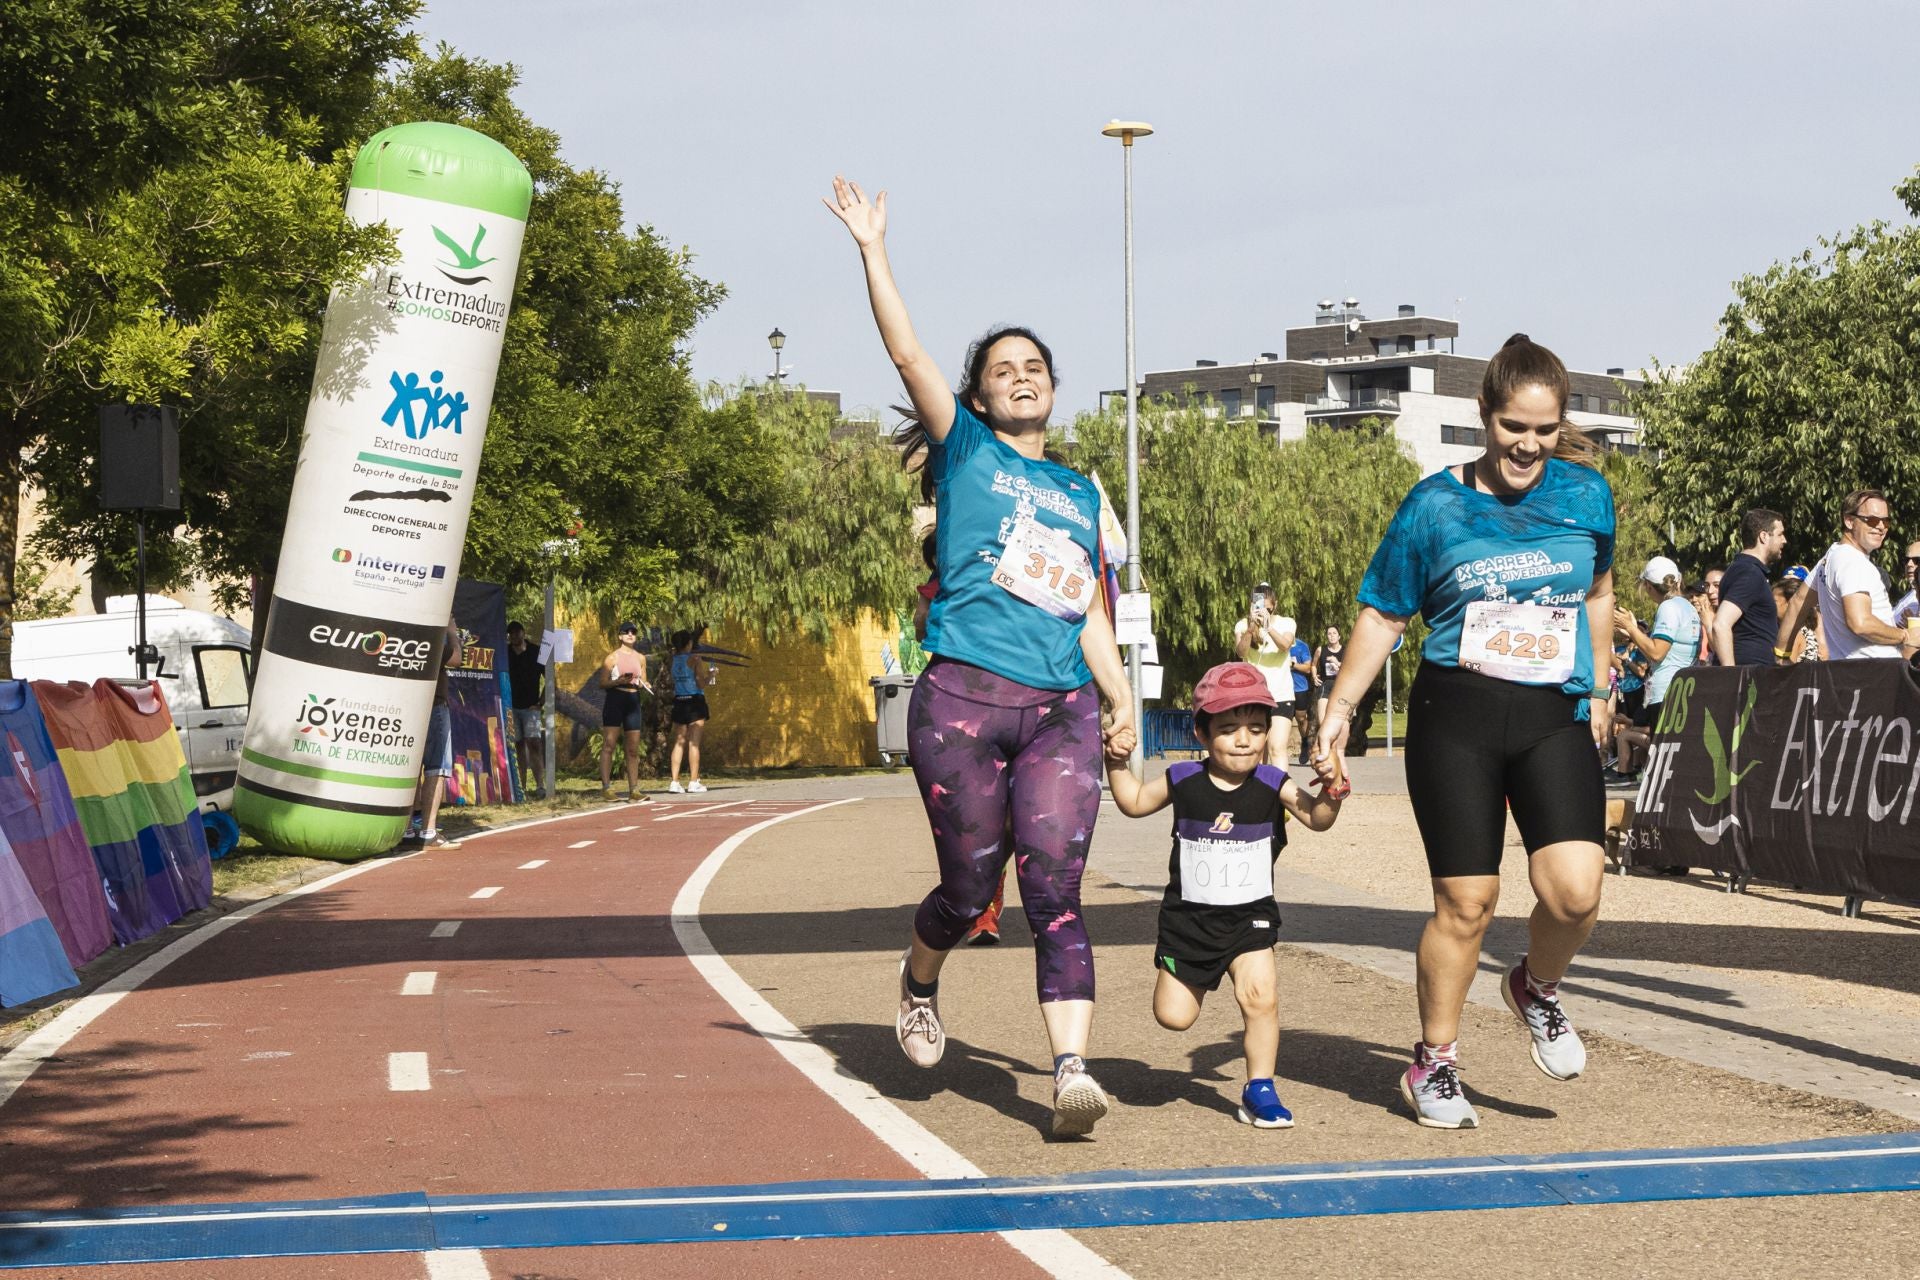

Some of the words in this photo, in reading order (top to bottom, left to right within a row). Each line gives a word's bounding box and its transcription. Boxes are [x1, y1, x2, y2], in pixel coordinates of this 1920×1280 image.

[386, 275, 506, 318] Extremadura
[387, 299, 501, 333] #SOMOSDEPORTE
[373, 436, 459, 462] Extremadura
[352, 463, 395, 481] Deporte
[398, 471, 428, 487] desde
[430, 477, 440, 489] la
[442, 479, 459, 491] Base
[994, 470, 1013, 487] IX
[1013, 476, 1079, 512] CARRERA
[343, 505, 396, 524] DIRECCION
[397, 515, 438, 531] GENERAL
[438, 521, 448, 532] DE
[1033, 496, 1092, 530] DIVERSIDAD
[371, 524, 422, 541] DEPORTES
[355, 569, 386, 582] España
[393, 576, 425, 588] Portugal
[357, 553, 428, 579] Interreg
[1024, 553, 1085, 600] 315
[1455, 563, 1473, 582] IX
[1472, 551, 1551, 575] CARRERA
[1500, 562, 1573, 582] DIVERSIDAD
[309, 624, 431, 660] euroace
[1485, 630, 1560, 659] 429
[378, 656, 428, 672] SPORT
[1464, 661, 1481, 672] 5K
[340, 697, 402, 715] fundación
[291, 739, 322, 756] JUNTA
[328, 744, 341, 758] DE
[346, 749, 410, 767] EXTREMADURA
[1770, 687, 1920, 826] Extre
[1195, 860, 1254, 888] 012
